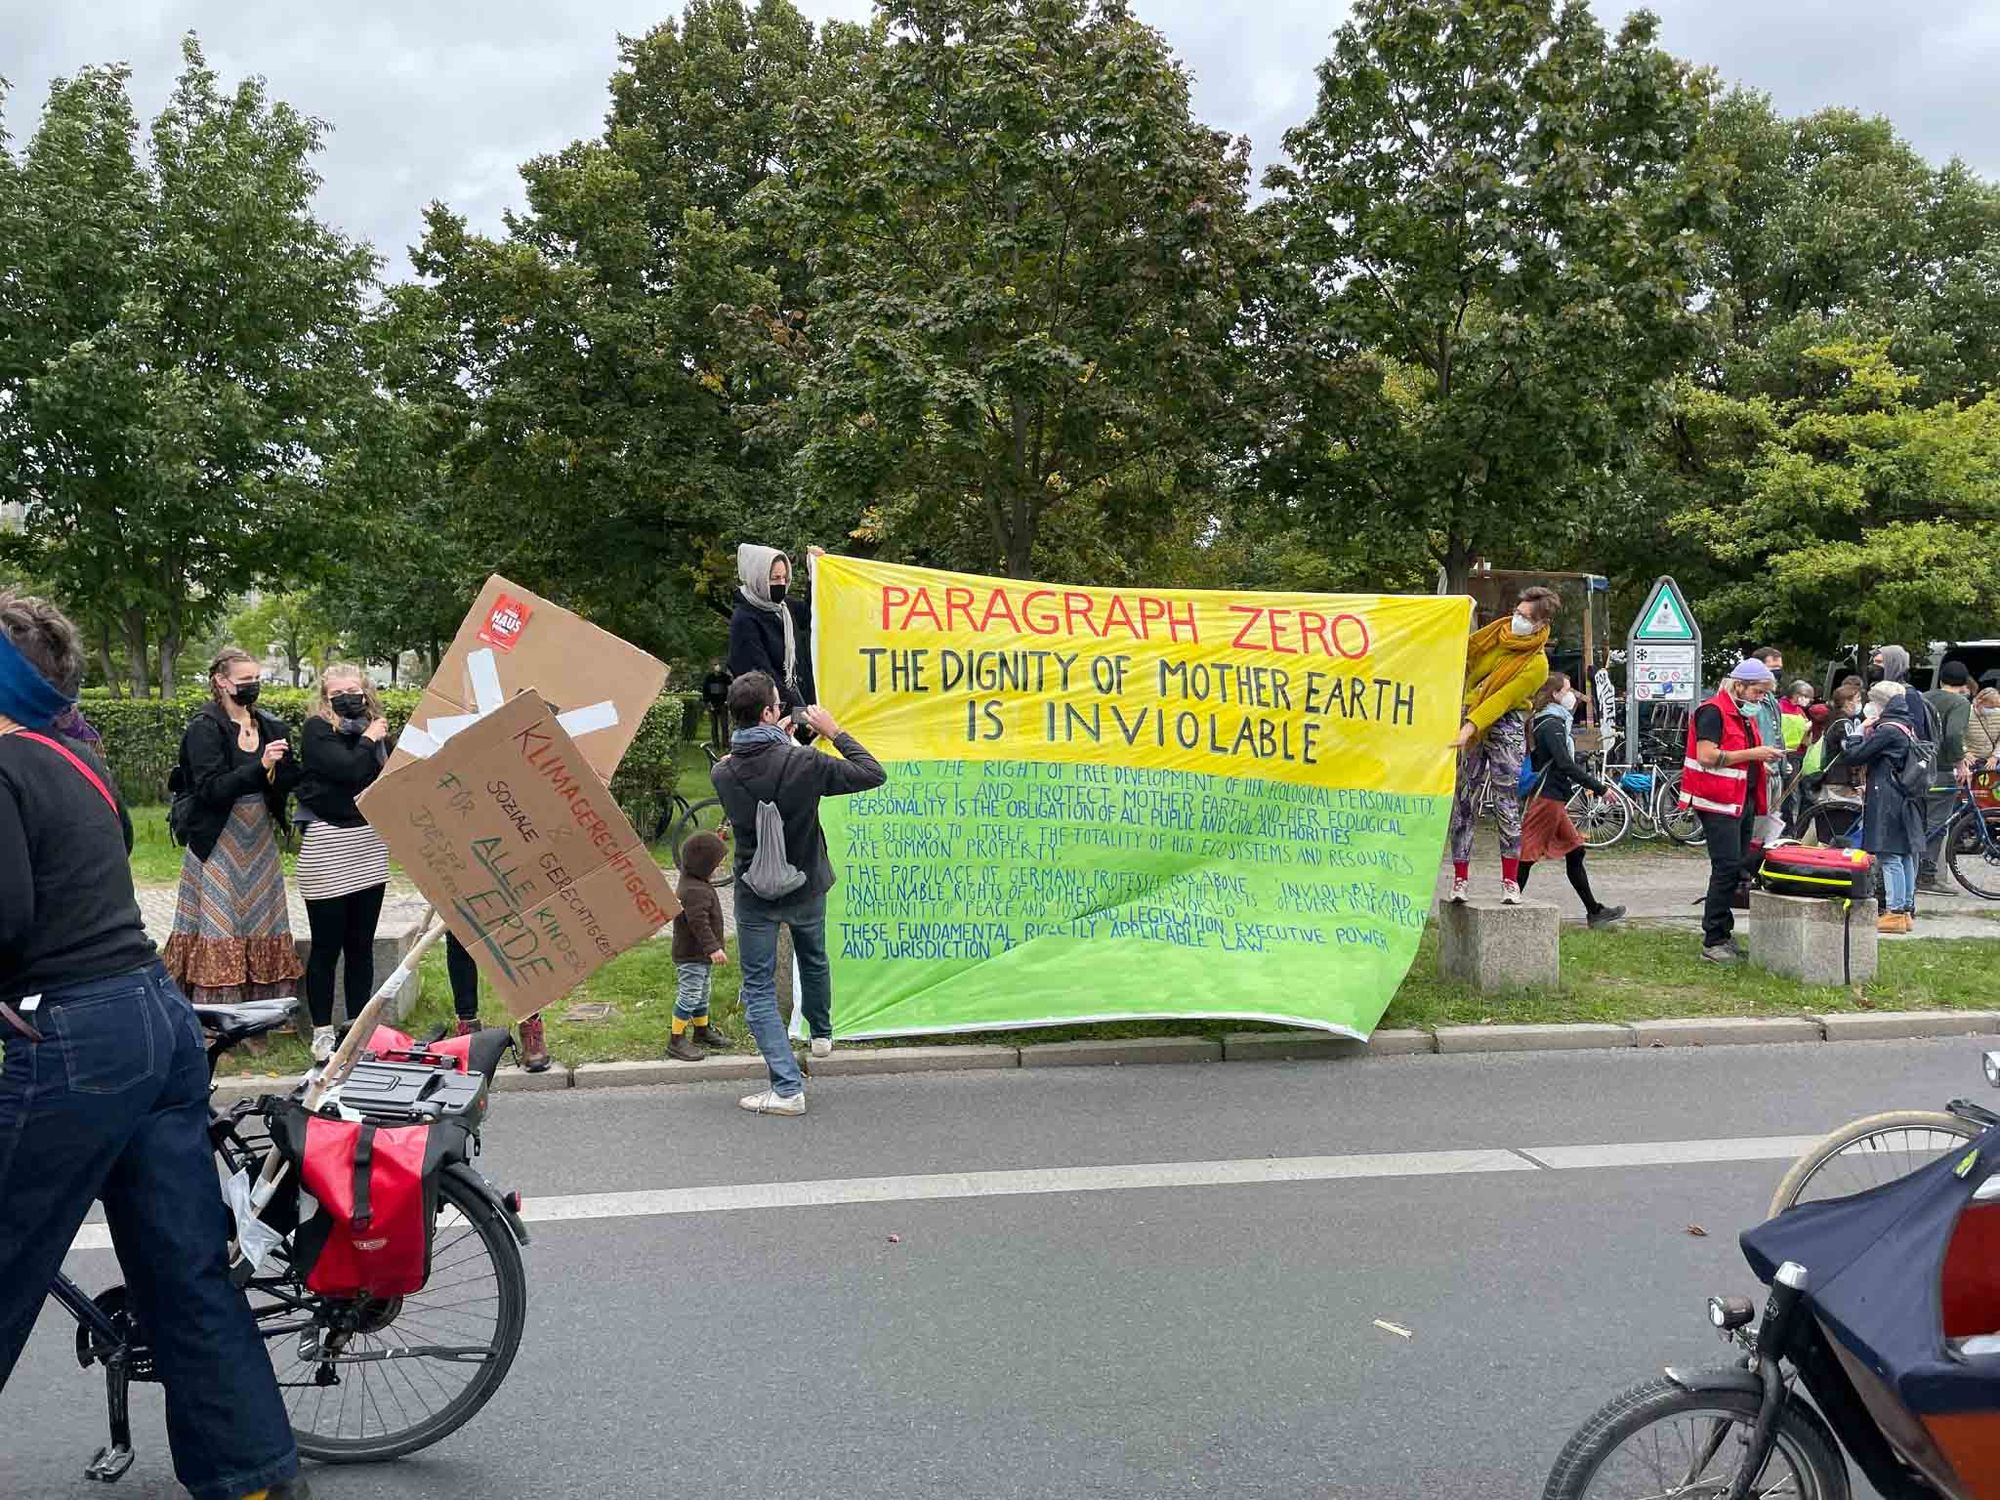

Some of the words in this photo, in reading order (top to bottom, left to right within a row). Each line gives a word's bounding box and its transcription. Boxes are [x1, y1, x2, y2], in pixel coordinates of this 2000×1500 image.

[492, 610, 521, 632] HAUS
[882, 586, 1199, 644] PARAGRAPH
[1229, 605, 1370, 660] ZERO
[859, 648, 929, 693] THE
[941, 649, 1078, 693] DIGNITY
[1091, 655, 1131, 695] OF
[1159, 658, 1291, 711] MOTHER
[1304, 671, 1415, 725] EARTH
[967, 700, 1004, 741] IS
[1047, 701, 1320, 764] INVIOLABLE
[936, 760, 967, 777] THE
[984, 760, 1038, 778] RIGHT
[1075, 764, 1108, 784] FREE
[1115, 766, 1215, 791] DEVELOPMENT
[1225, 776, 1240, 794] OF
[1269, 781, 1331, 808] ECOLOGICAL
[487, 780, 539, 843] SOZIALE
[850, 799, 946, 816] PERSONALITY
[955, 799, 965, 816] IS
[972, 798, 999, 816] THE
[1006, 799, 1094, 821] OBLIGATION
[1099, 805, 1117, 823] OF
[1120, 807, 1145, 825] ALL
[1201, 815, 1225, 834] AND
[1229, 818, 1252, 835] CIVIL
[878, 782, 960, 801] RESPECT
[976, 783, 1013, 800] AND
[1027, 784, 1110, 804] PROTECT
[1124, 789, 1194, 813] MOTHER
[1202, 795, 1248, 818] EARTH
[1256, 804, 1281, 824] AND
[1287, 807, 1321, 827] HER
[1328, 810, 1406, 836] ECOLOGICAL
[846, 840, 880, 859] ARE
[885, 840, 951, 859] COMMON
[847, 824, 873, 841] SHE
[883, 823, 940, 842] BELONGS
[949, 824, 961, 840] TO
[1039, 827, 1069, 846] THE
[1074, 828, 1141, 849] TOTALITY
[1150, 834, 1166, 851] OF
[1297, 848, 1321, 866] AND
[437, 772, 476, 820] FÜR
[476, 836, 537, 899] ALLE
[533, 906, 587, 973] KINDER
[844, 864, 882, 884] THE
[891, 865, 973, 885] POPULACE
[982, 865, 1000, 883] OF
[1009, 866, 1088, 887] GERMANY
[1202, 870, 1248, 894] ABOVE
[1281, 882, 1377, 900] INVIOLABLE
[1381, 890, 1411, 909] AND
[954, 883, 1002, 900] RIGHTS
[1009, 884, 1027, 899] OF
[1034, 885, 1097, 906] MOTHER
[838, 922, 889, 941] THESE
[897, 922, 1016, 941] FUNDAMENTAL
[1130, 905, 1224, 934] LEGISLATION
[1235, 922, 1328, 944] EXECUTIVE
[1336, 927, 1389, 953] POWER
[845, 900, 936, 918] COMMUNITY
[965, 900, 1014, 918] PEACE
[1021, 901, 1045, 918] AND
[465, 889, 554, 985] ERDE
[840, 941, 875, 959] AND
[882, 940, 990, 959] JURISDICTION
[1111, 920, 1209, 947] APPLICABLE
